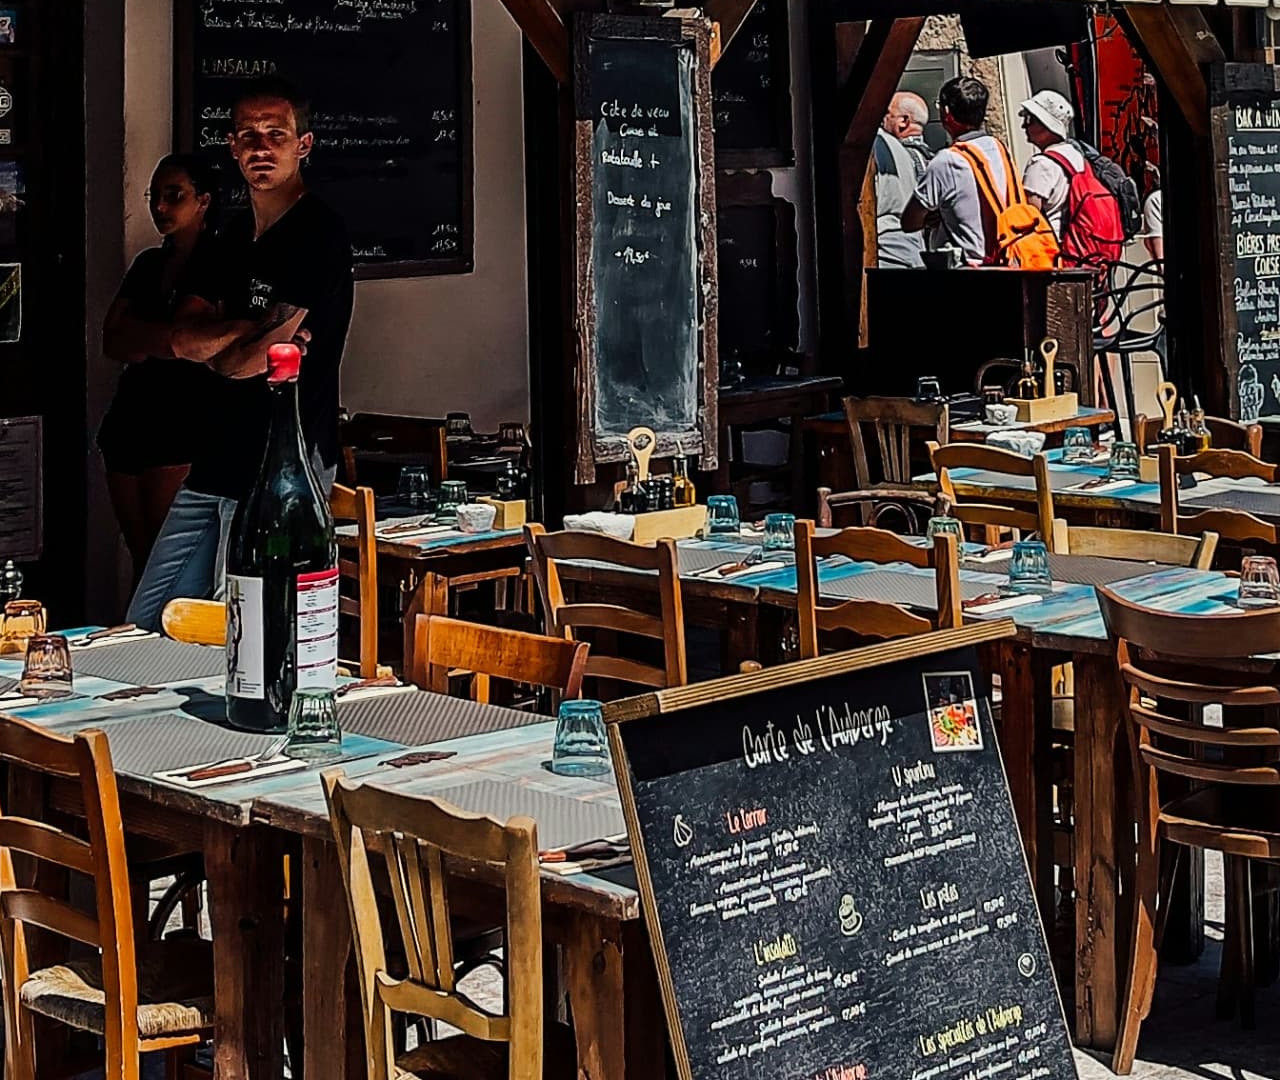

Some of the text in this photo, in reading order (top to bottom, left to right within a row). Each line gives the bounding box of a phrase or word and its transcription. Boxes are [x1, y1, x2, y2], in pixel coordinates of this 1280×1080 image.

[631, 103, 644, 118] de
[742, 719, 789, 769] Carte
[793, 714, 816, 755] de
